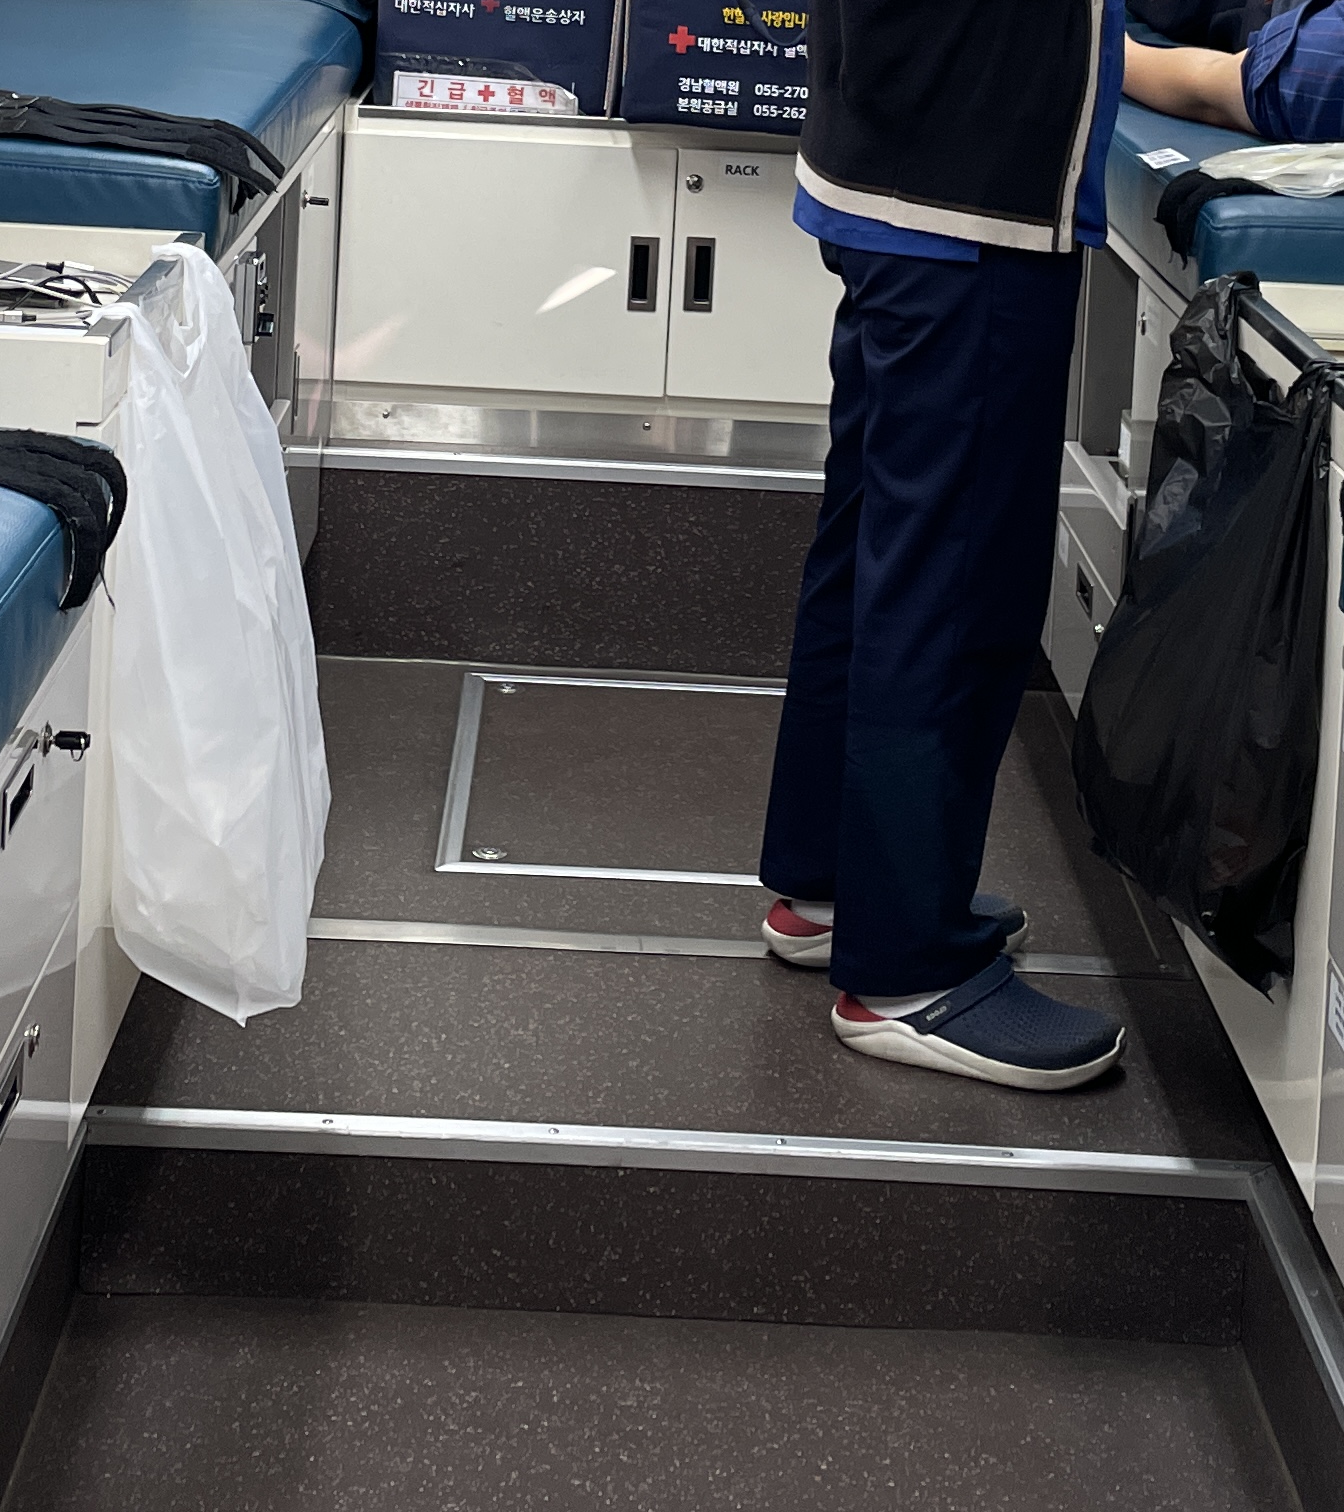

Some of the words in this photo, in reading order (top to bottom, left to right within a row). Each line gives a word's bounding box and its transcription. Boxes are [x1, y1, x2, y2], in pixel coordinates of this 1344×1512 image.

[504, 4, 586, 26] 혈액운송상자
[722, 7, 750, 25] 헌혈
[761, 10, 810, 29] 사랑입니
[417, 79, 467, 101] 긴급
[678, 77, 740, 96] 경남혈액원
[754, 83, 809, 99] 055-270
[676, 97, 739, 117] 본원공급실
[753, 104, 807, 120] 055-262
[725, 164, 760, 176] RACK
